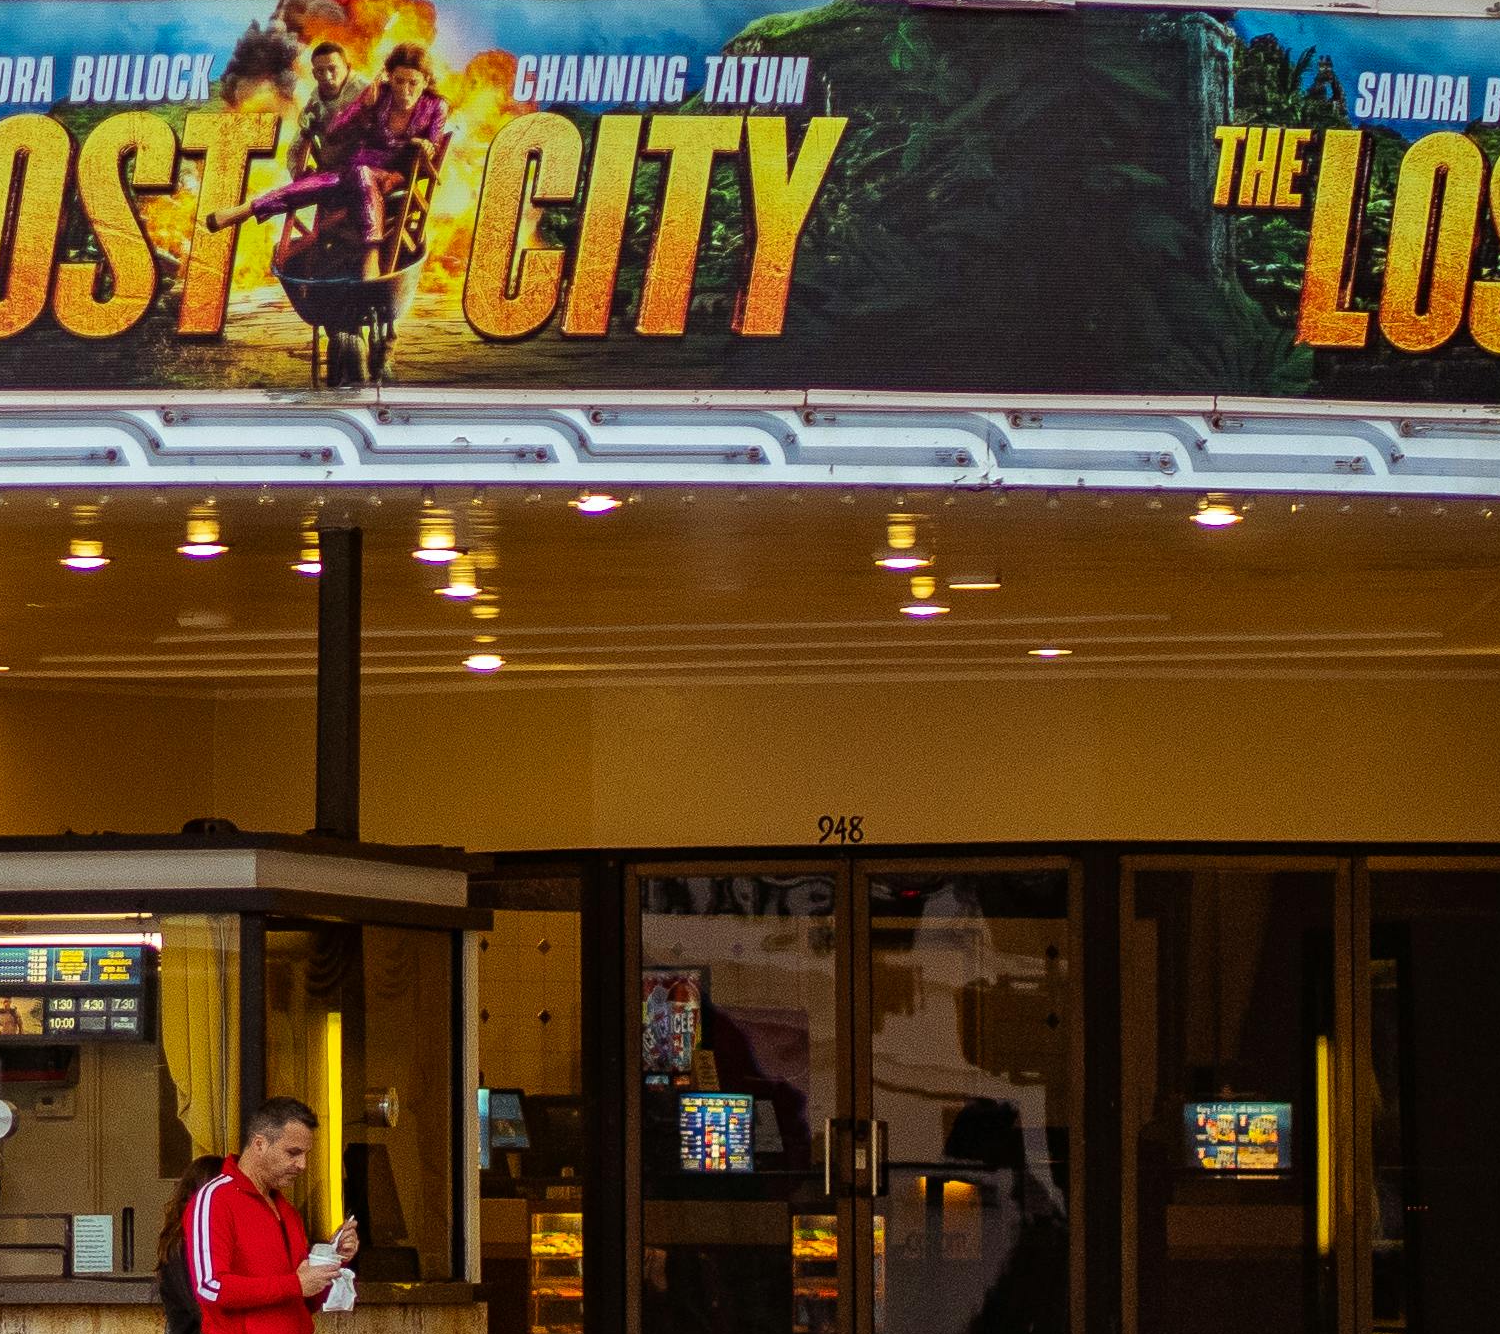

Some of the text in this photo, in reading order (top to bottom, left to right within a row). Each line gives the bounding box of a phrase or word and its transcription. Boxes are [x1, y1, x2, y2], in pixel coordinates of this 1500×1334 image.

[70, 53, 211, 103] BULLOCK
[514, 54, 809, 105] CHANNING TATUM
[1355, 70, 1469, 124] SANDRA
[1212, 126, 1312, 210] THE
[461, 111, 850, 340] CITY
[818, 816, 864, 844] 948
[50, 1017, 75, 1029] 10:00
[53, 999, 73, 1010] 1:30
[115, 998, 135, 1009] 7:30
